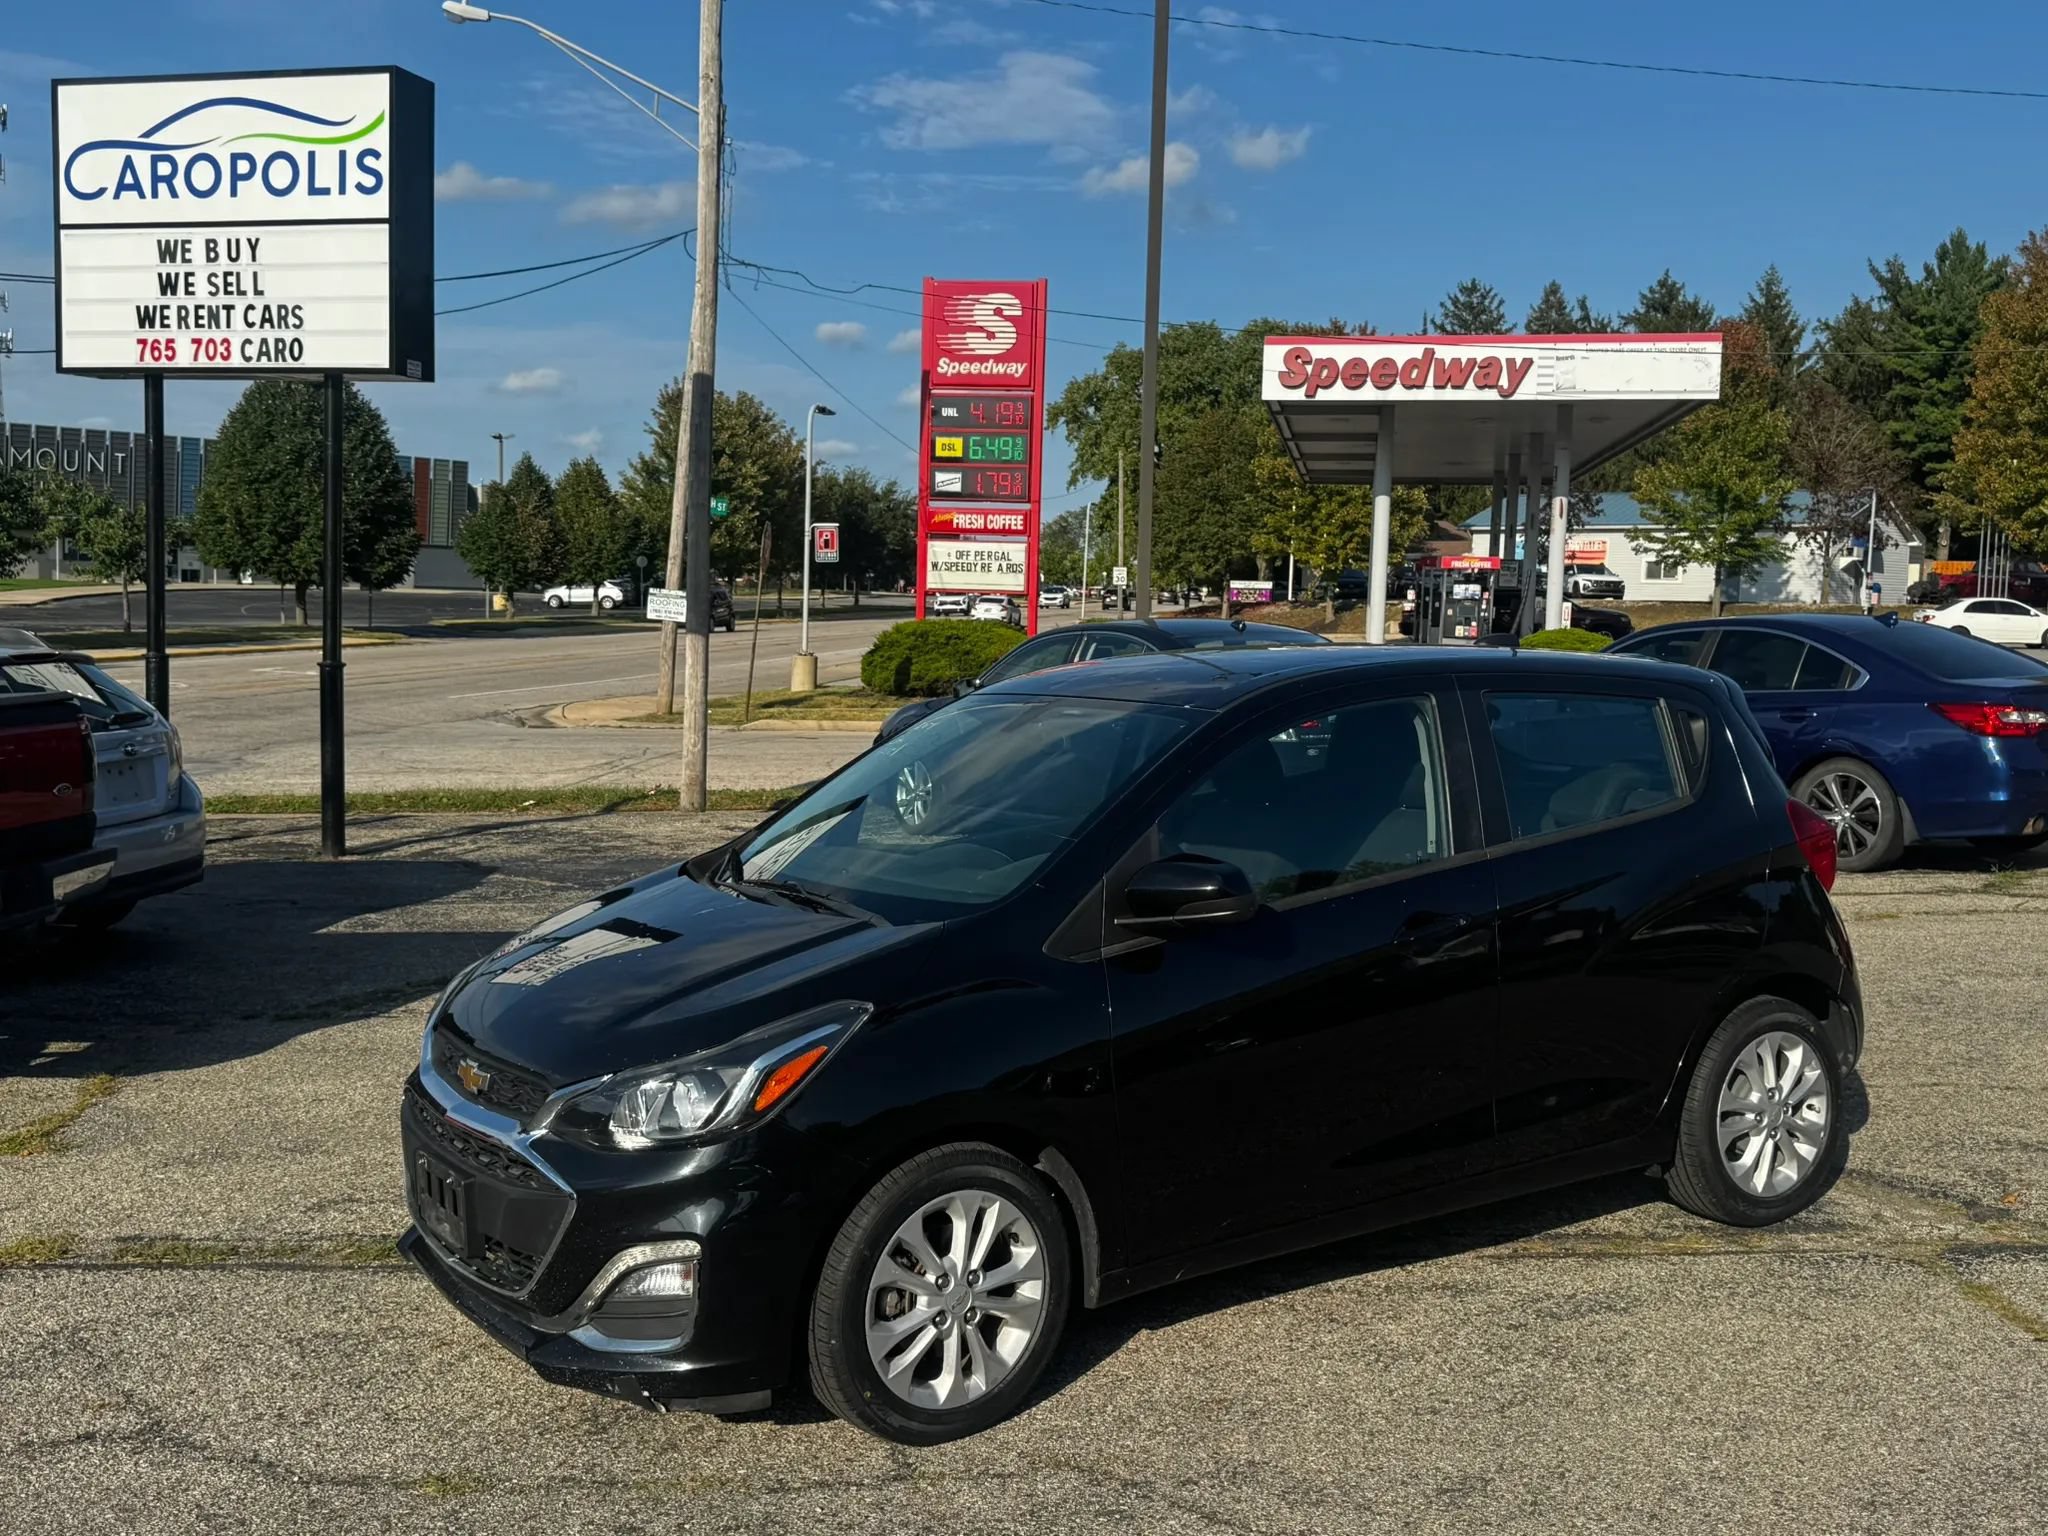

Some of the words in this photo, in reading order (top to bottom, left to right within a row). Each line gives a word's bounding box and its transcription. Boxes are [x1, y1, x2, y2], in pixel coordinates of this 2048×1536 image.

[64, 140, 384, 201] CAROPOLIS
[157, 239, 193, 264] WE
[205, 237, 261, 262] BUY
[158, 272, 196, 297] WE
[207, 271, 265, 297] SELL
[243, 303, 305, 330] CARS
[136, 338, 177, 363] 765
[190, 338, 232, 363] 703
[240, 338, 304, 363] CARO
[936, 357, 1028, 378] Speedway
[1278, 346, 1534, 398] Speedway
[941, 407, 959, 417] UNL
[941, 443, 957, 452] DSL
[953, 514, 985, 529] FRESH
[987, 514, 1024, 530] COFFEE
[955, 550, 971, 560] OFF
[931, 561, 979, 572] W/SPEEDY
[650, 598, 685, 608] ROOFING
